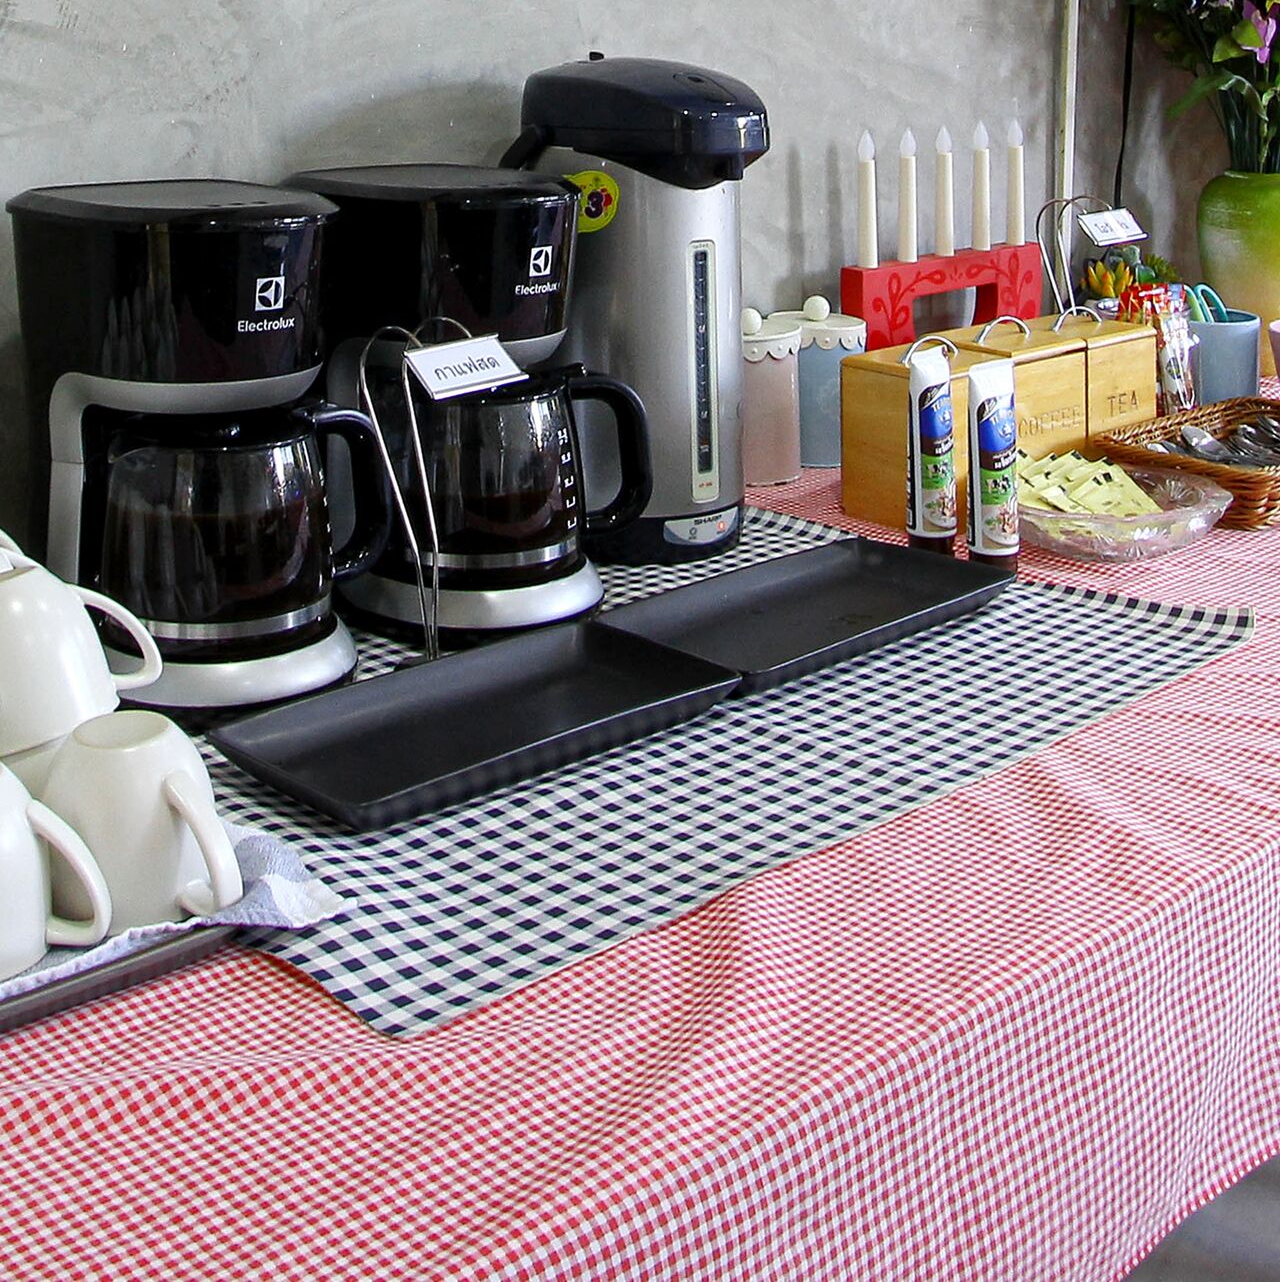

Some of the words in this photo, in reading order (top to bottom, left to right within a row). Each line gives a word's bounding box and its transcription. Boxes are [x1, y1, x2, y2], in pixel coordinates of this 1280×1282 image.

[515, 282, 560, 295] Electrolux
[237, 317, 295, 332] Electrolux
[434, 356, 500, 380] กาแฟสด
[1107, 390, 1138, 417] TEA
[1018, 405, 1081, 439] COFFEE
